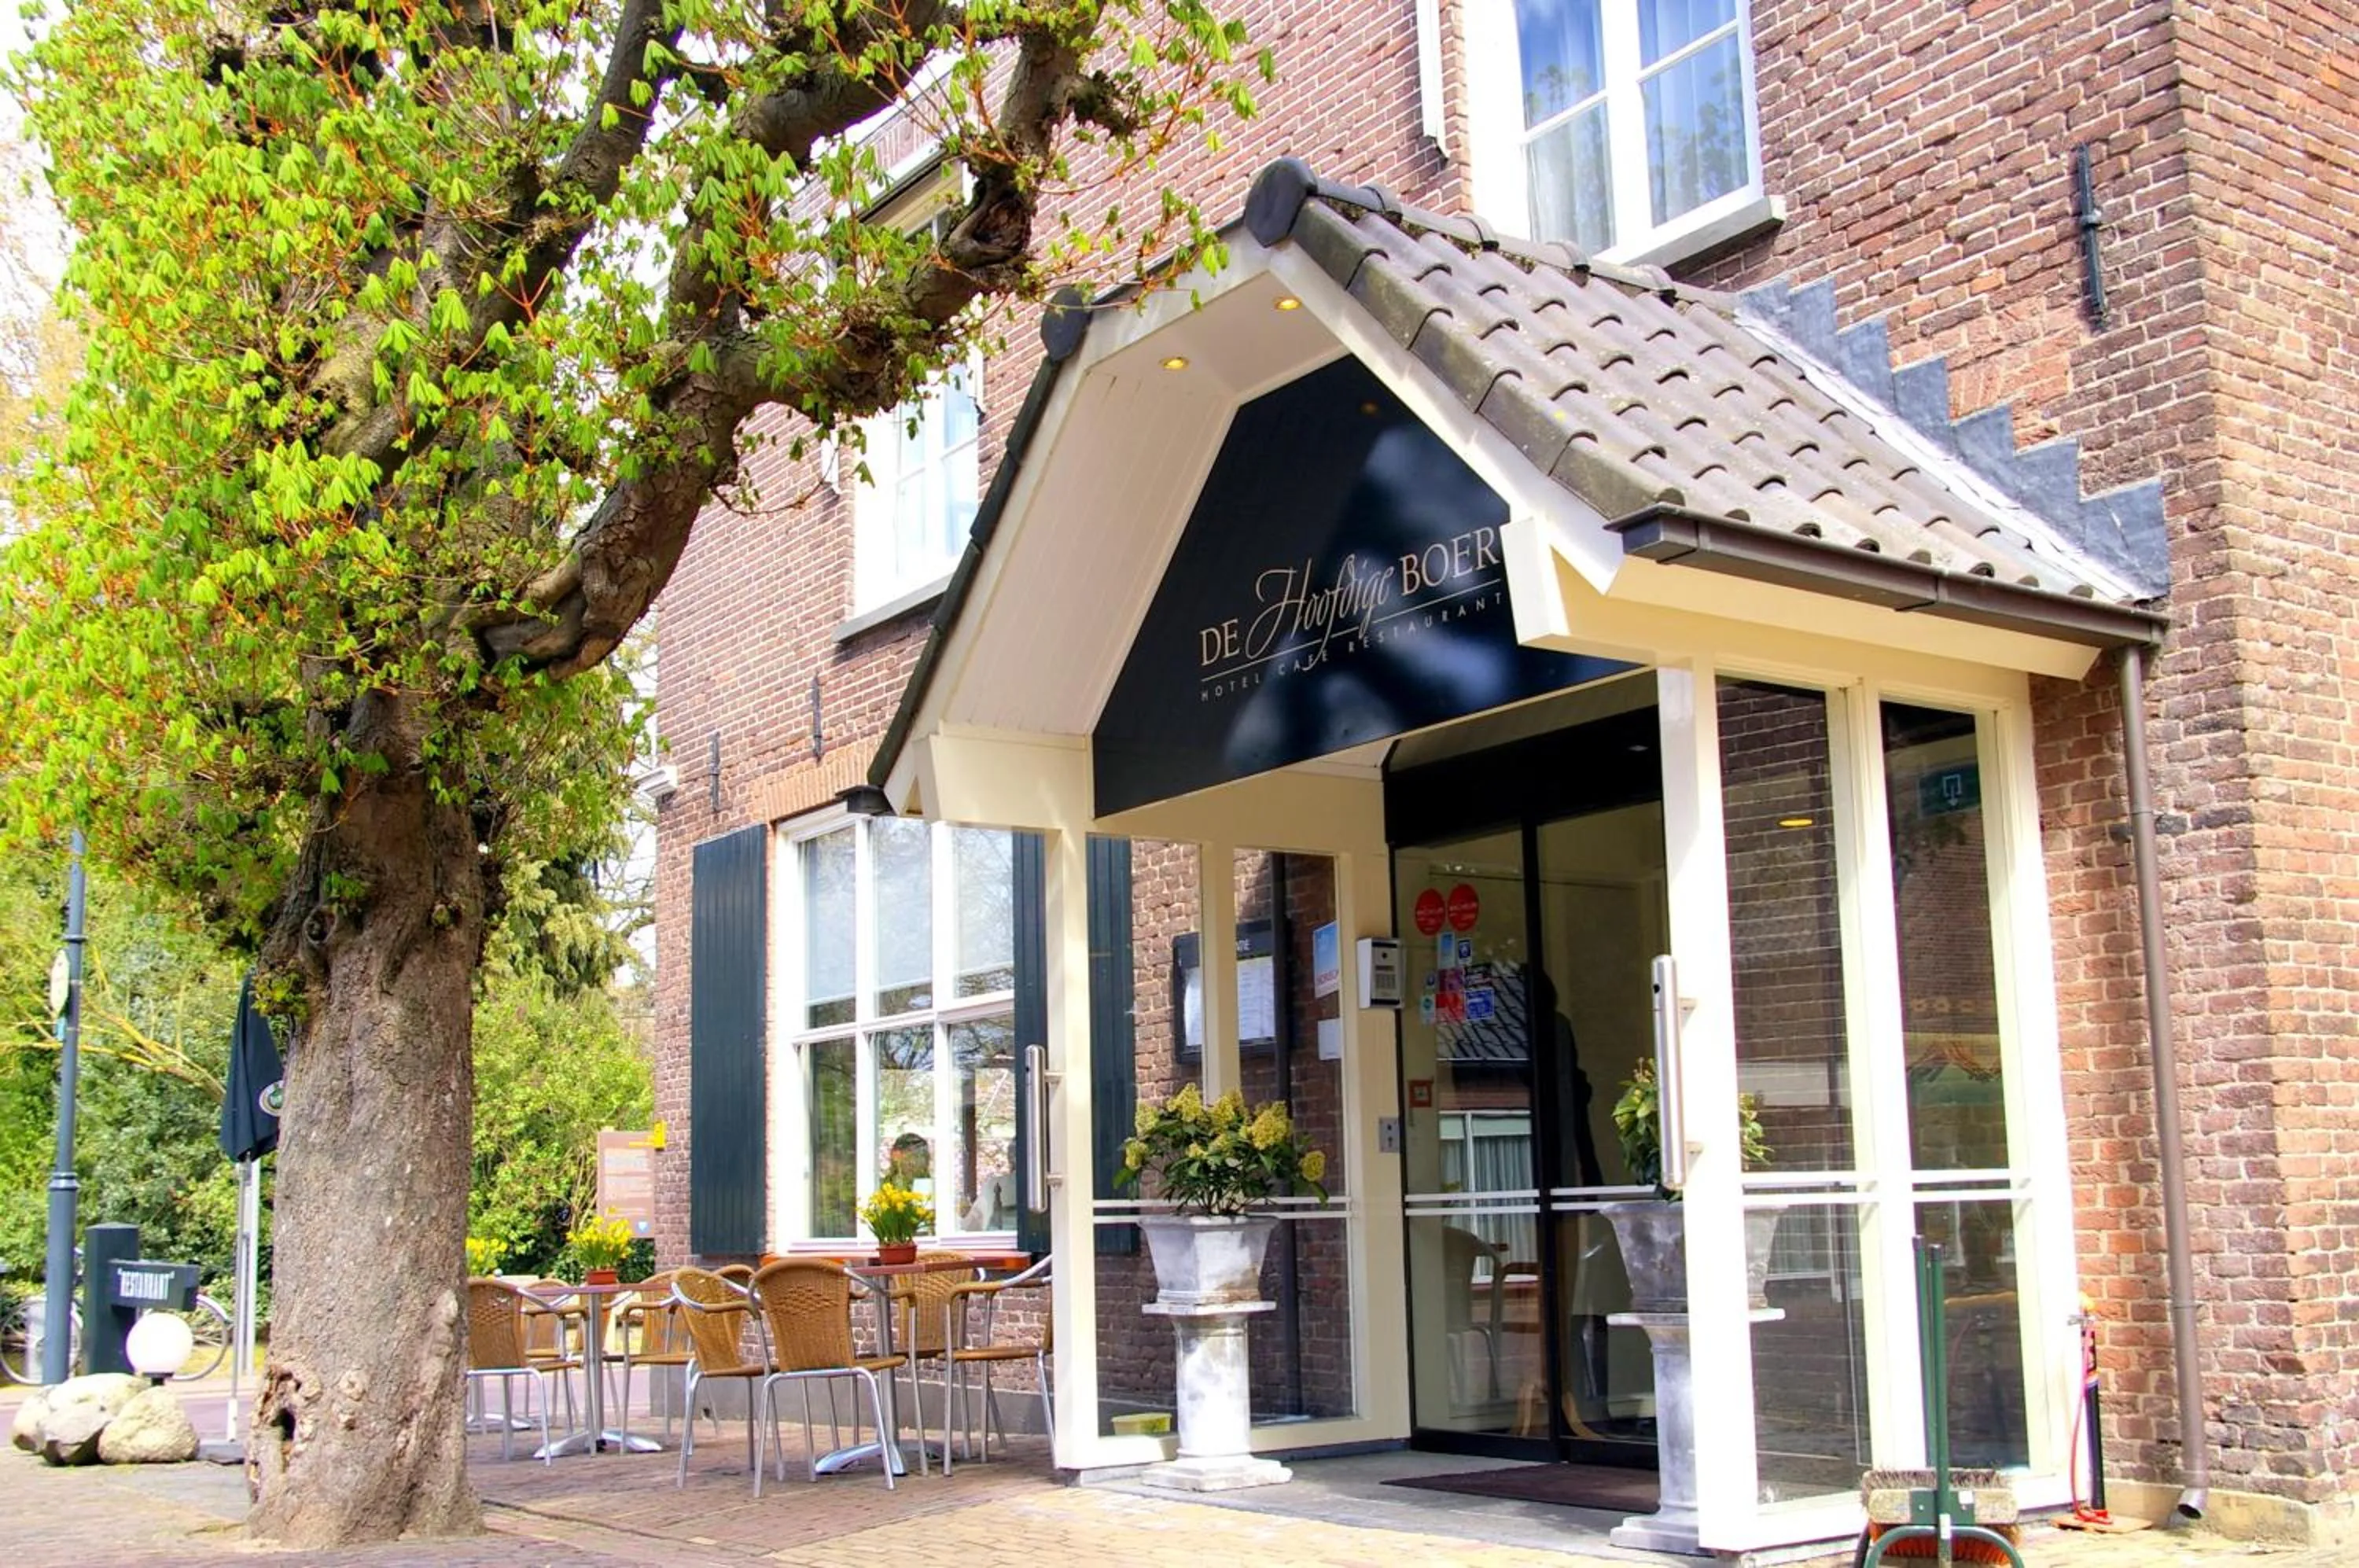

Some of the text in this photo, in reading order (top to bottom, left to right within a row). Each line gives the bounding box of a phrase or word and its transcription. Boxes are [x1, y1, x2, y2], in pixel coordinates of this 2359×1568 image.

[1199, 526, 1501, 672] DE Hoofdige BOER
[1201, 673, 1260, 701] HOTEL
[1348, 592, 1502, 653] RESTAURANT
